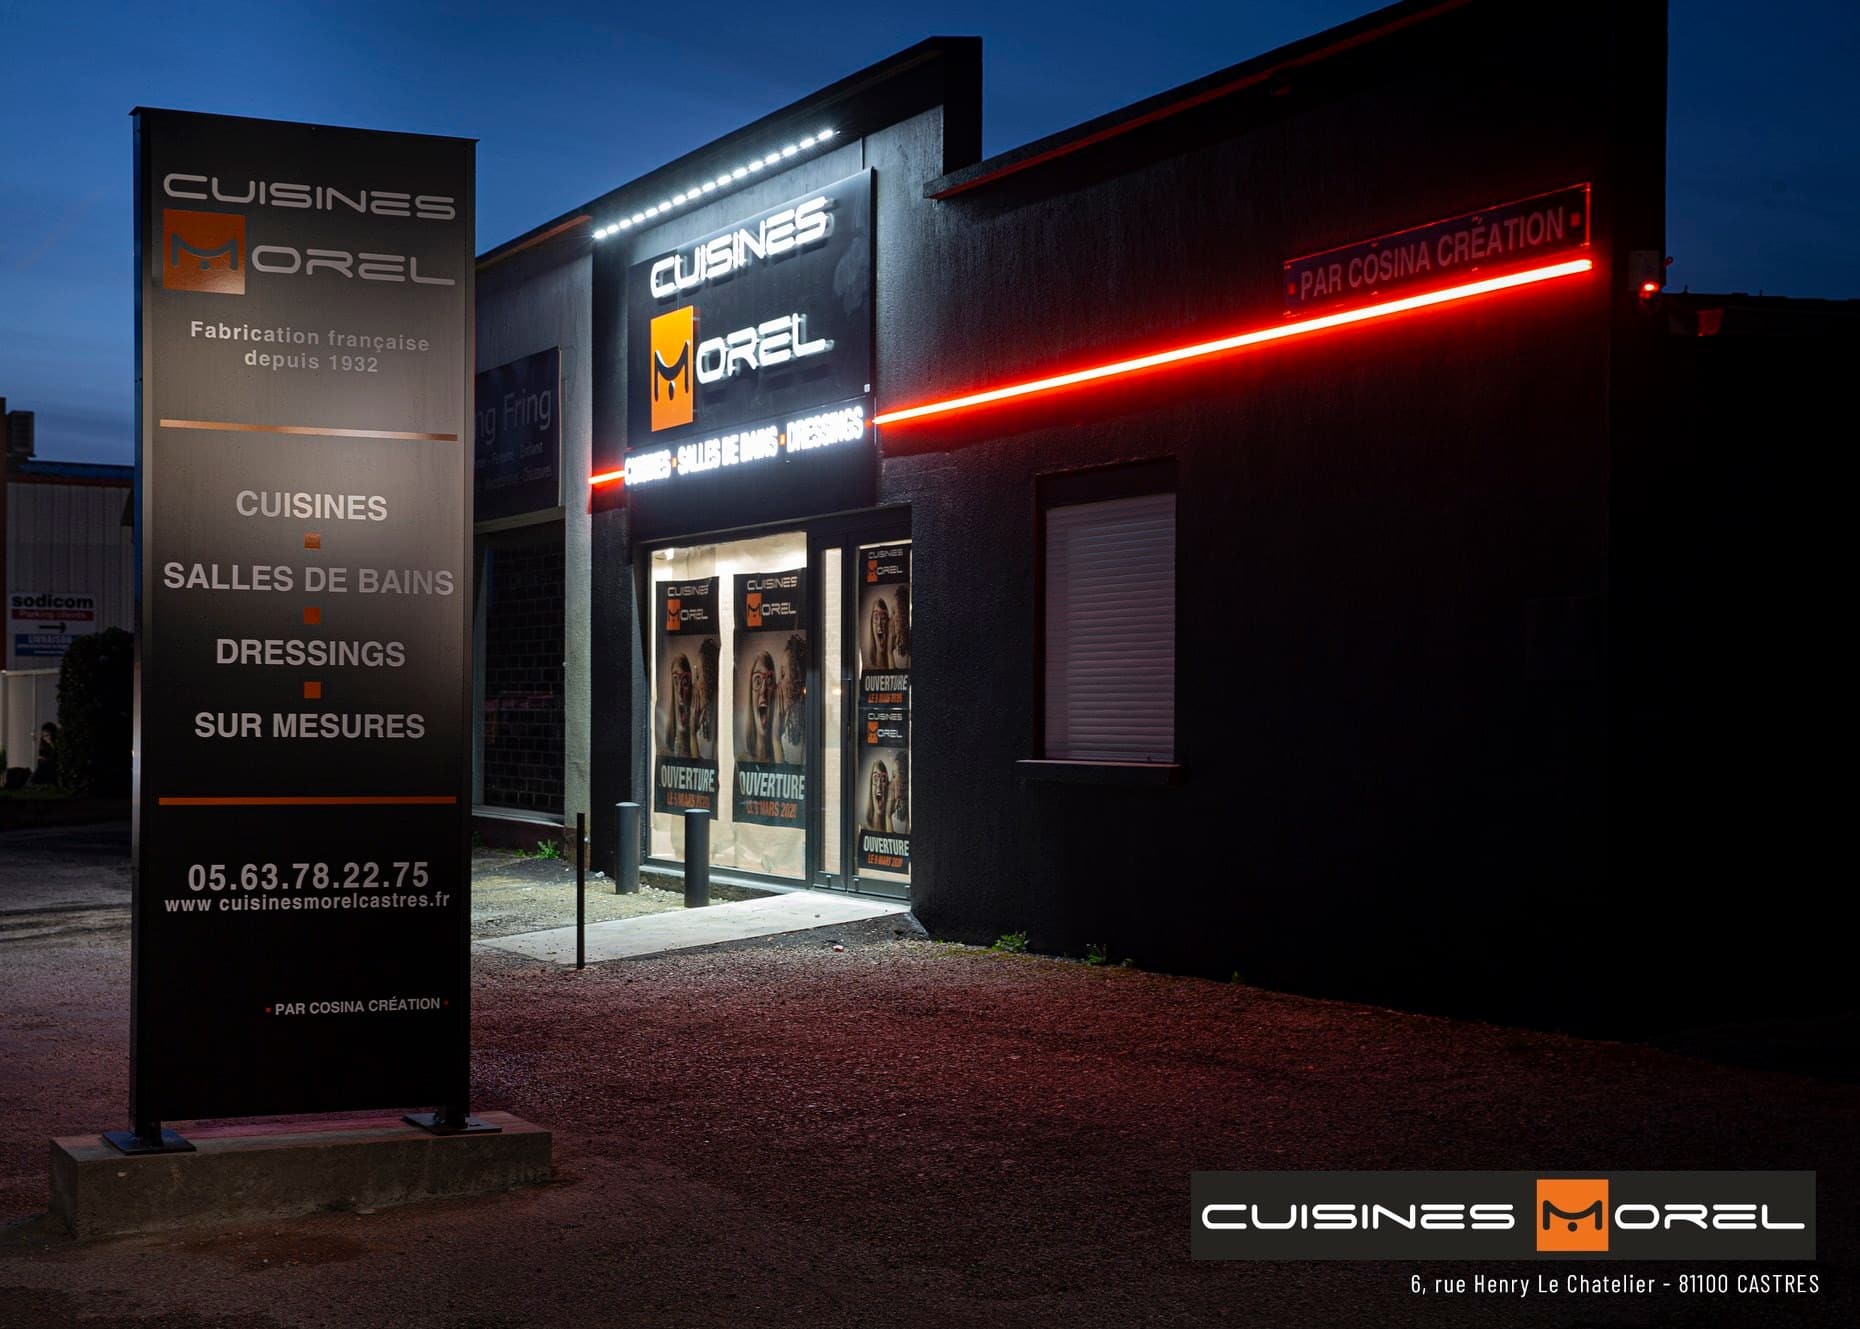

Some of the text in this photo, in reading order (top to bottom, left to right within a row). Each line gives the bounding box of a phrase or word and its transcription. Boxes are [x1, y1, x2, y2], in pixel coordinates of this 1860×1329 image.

[163, 173, 456, 221] CUISINES
[170, 232, 455, 286] MOREL
[651, 196, 830, 299] CUISINES
[1301, 206, 1564, 300] PAR COSINA CRÉATION
[191, 321, 430, 353] Fabrication française
[244, 350, 378, 373] depuis 1932
[655, 313, 828, 402] MOREL
[504, 388, 551, 432] Fring
[236, 489, 388, 521] CUISINES
[163, 562, 454, 595] SALLES DE BAINS
[747, 576, 799, 591] CUISINES
[12, 593, 94, 609] sodicom
[216, 638, 406, 667] DRESSINGS
[865, 675, 909, 691] OUVERTURE
[194, 712, 425, 739] SUR MESURES
[661, 764, 716, 793] OUVERTURE
[739, 770, 806, 800] OUVERTURE
[864, 835, 910, 857] OUVERTURE
[188, 861, 429, 891] 05.63.78.22.75
[165, 891, 450, 912] www cuisinesmorelcastres.fr
[275, 996, 441, 1016] PAR COSINA CRÉATION
